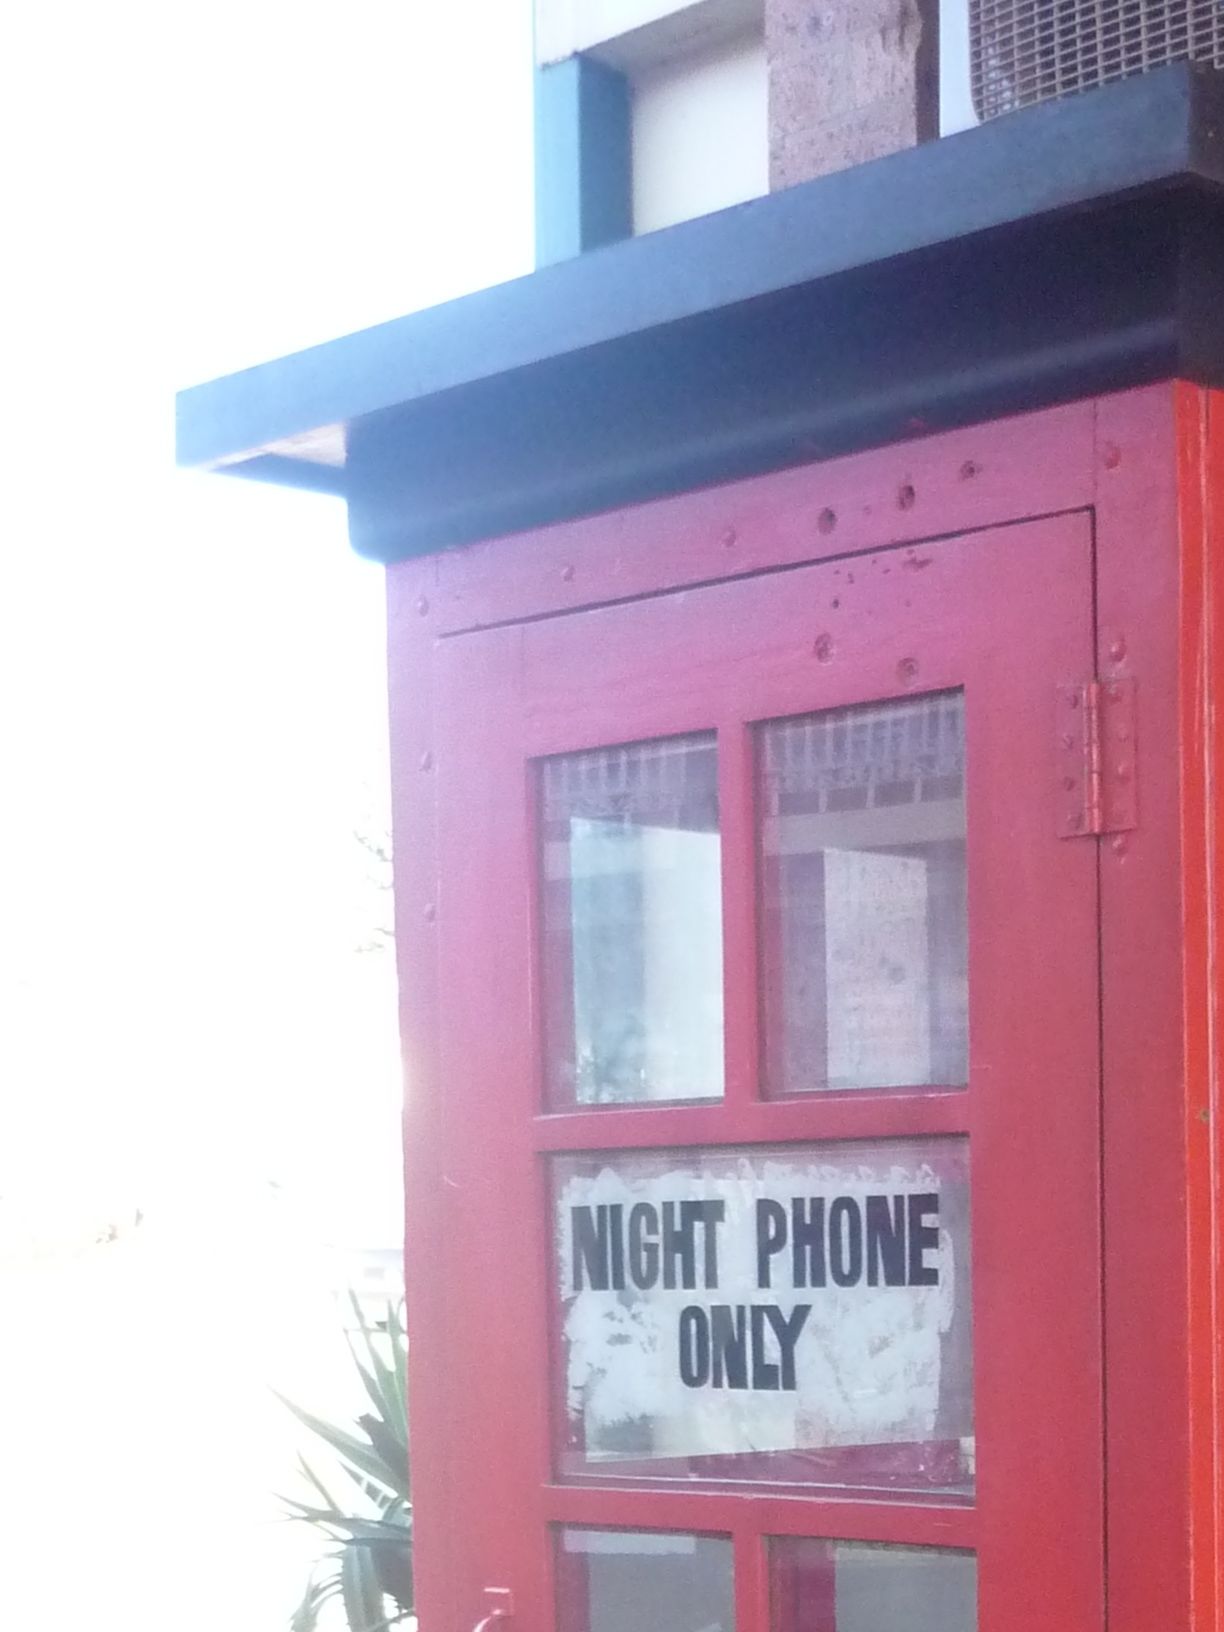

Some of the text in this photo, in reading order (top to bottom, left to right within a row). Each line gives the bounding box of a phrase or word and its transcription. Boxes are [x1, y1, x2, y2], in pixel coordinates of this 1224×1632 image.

[571, 1193, 940, 1291] NIGHT PHONE
[679, 1304, 812, 1392] ONLY
